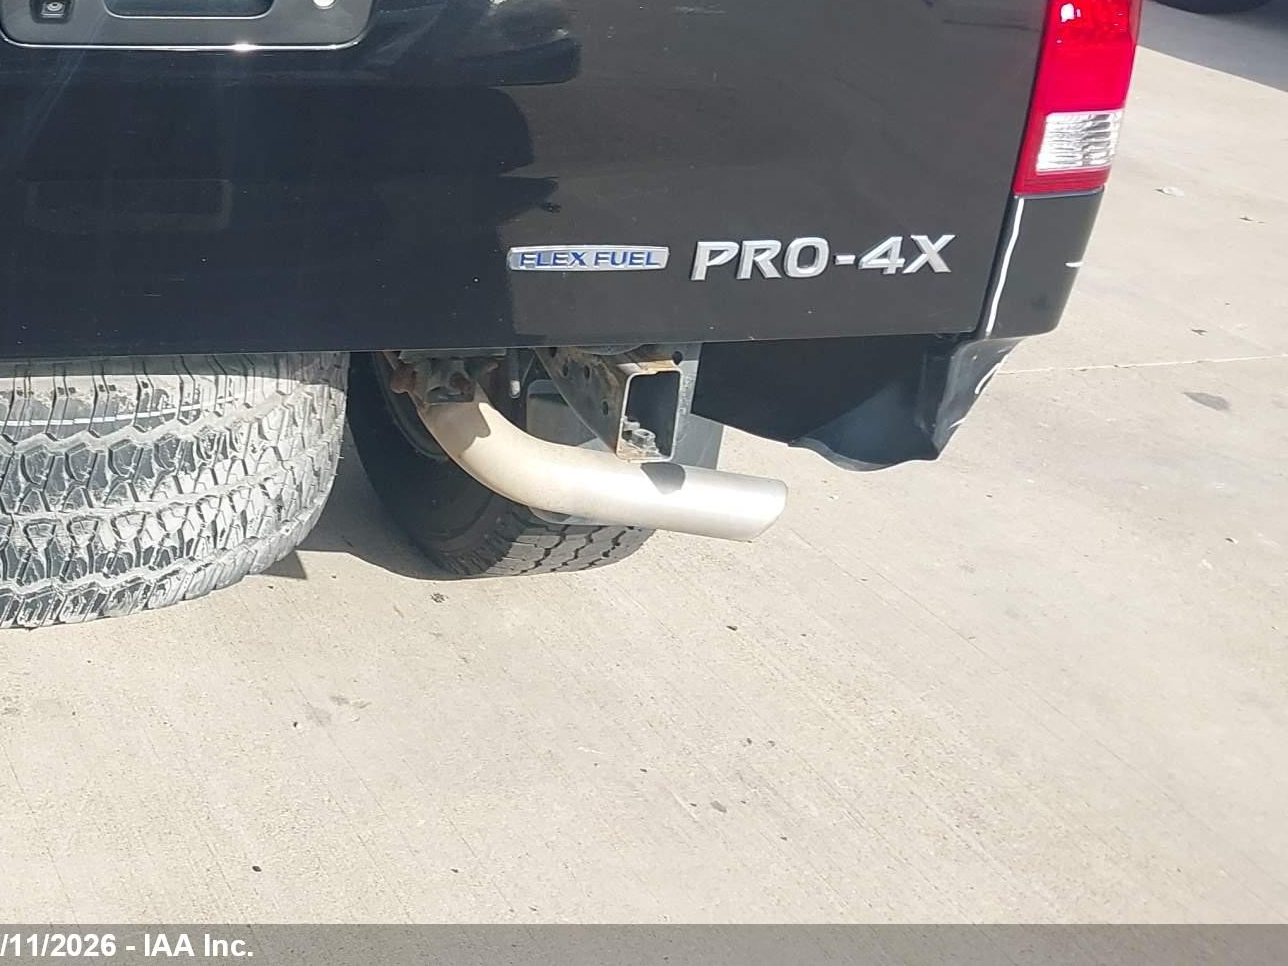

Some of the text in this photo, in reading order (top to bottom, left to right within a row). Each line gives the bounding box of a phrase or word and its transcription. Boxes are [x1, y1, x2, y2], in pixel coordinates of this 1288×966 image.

[519, 251, 661, 267] FLEX FUEL
[691, 234, 955, 281] PRO-4X
